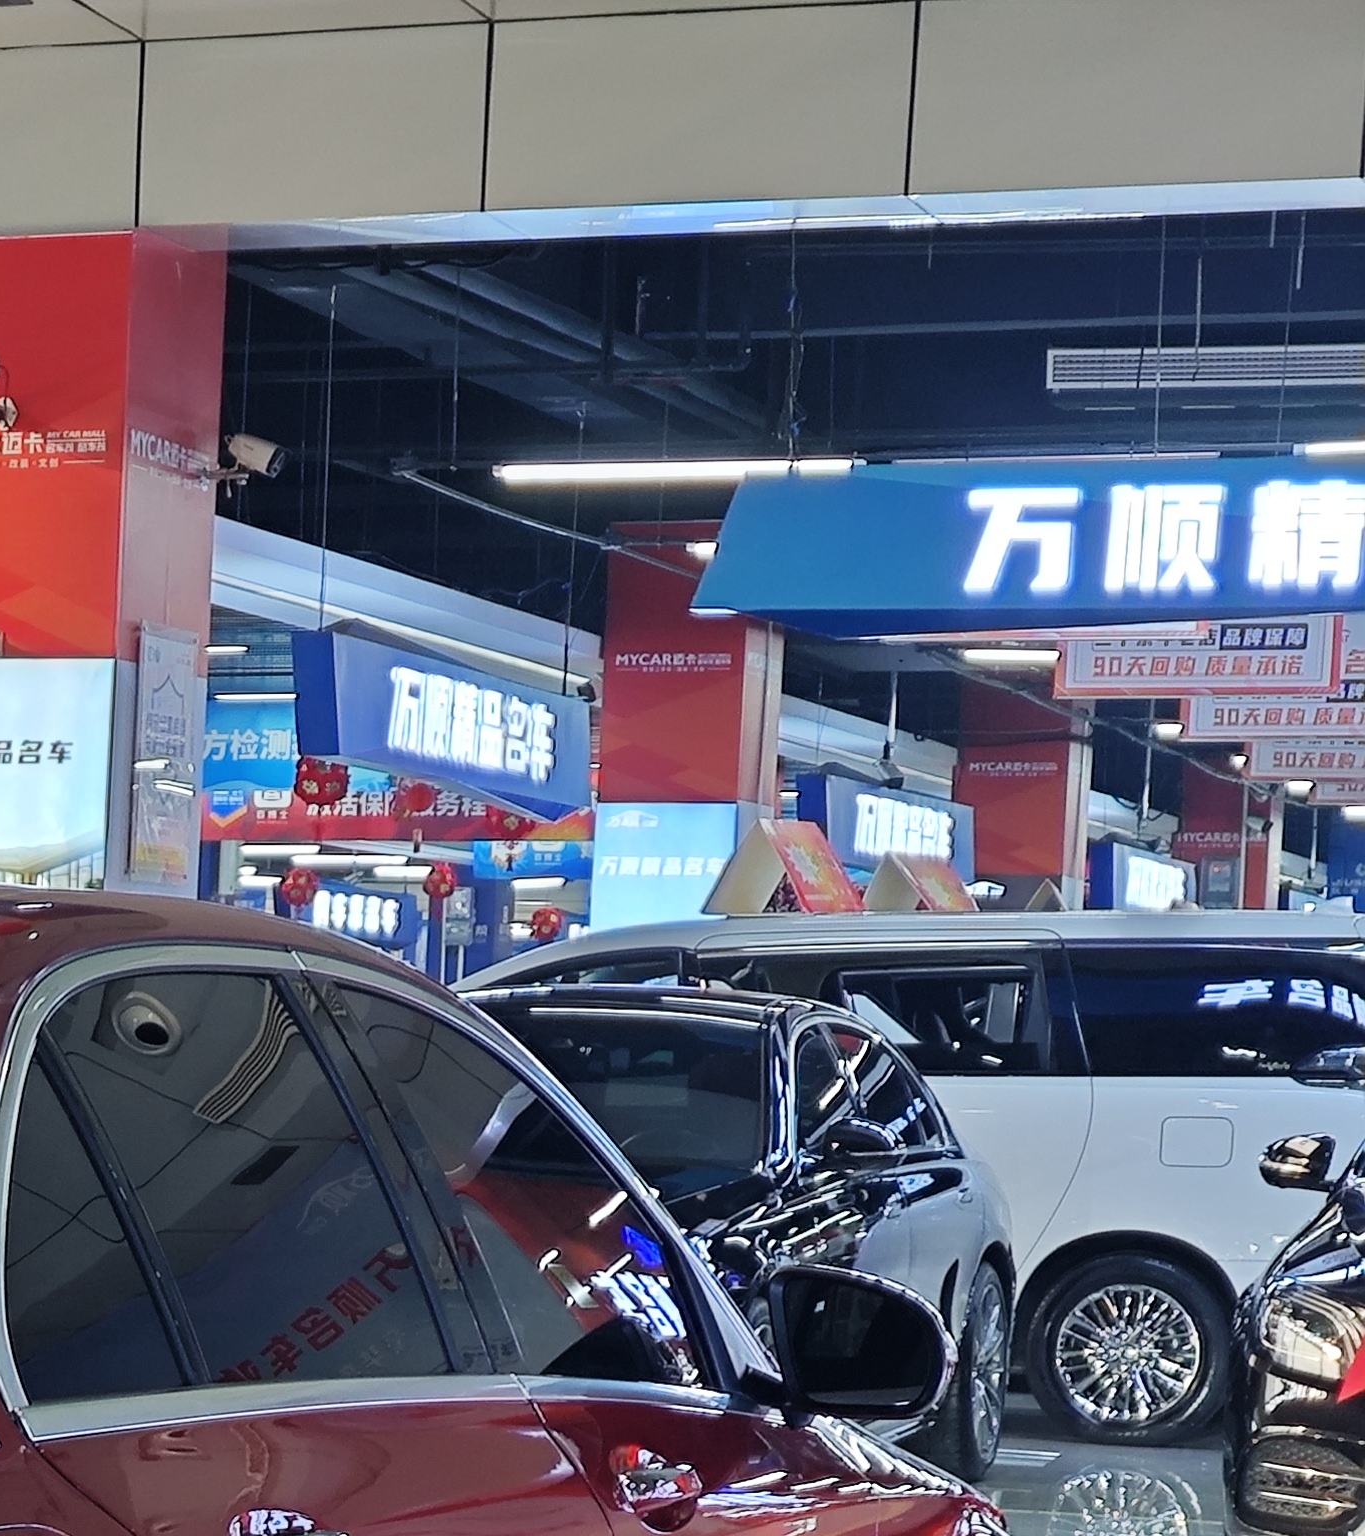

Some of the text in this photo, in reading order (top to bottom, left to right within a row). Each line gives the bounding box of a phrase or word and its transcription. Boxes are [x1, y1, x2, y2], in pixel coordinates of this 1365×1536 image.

[1221, 627, 1307, 647] 品牌保障
[1092, 654, 1304, 676] 90天回购 质量承诺
[386, 666, 557, 782] 万顺精品名车
[1313, 707, 1365, 726] 质量
